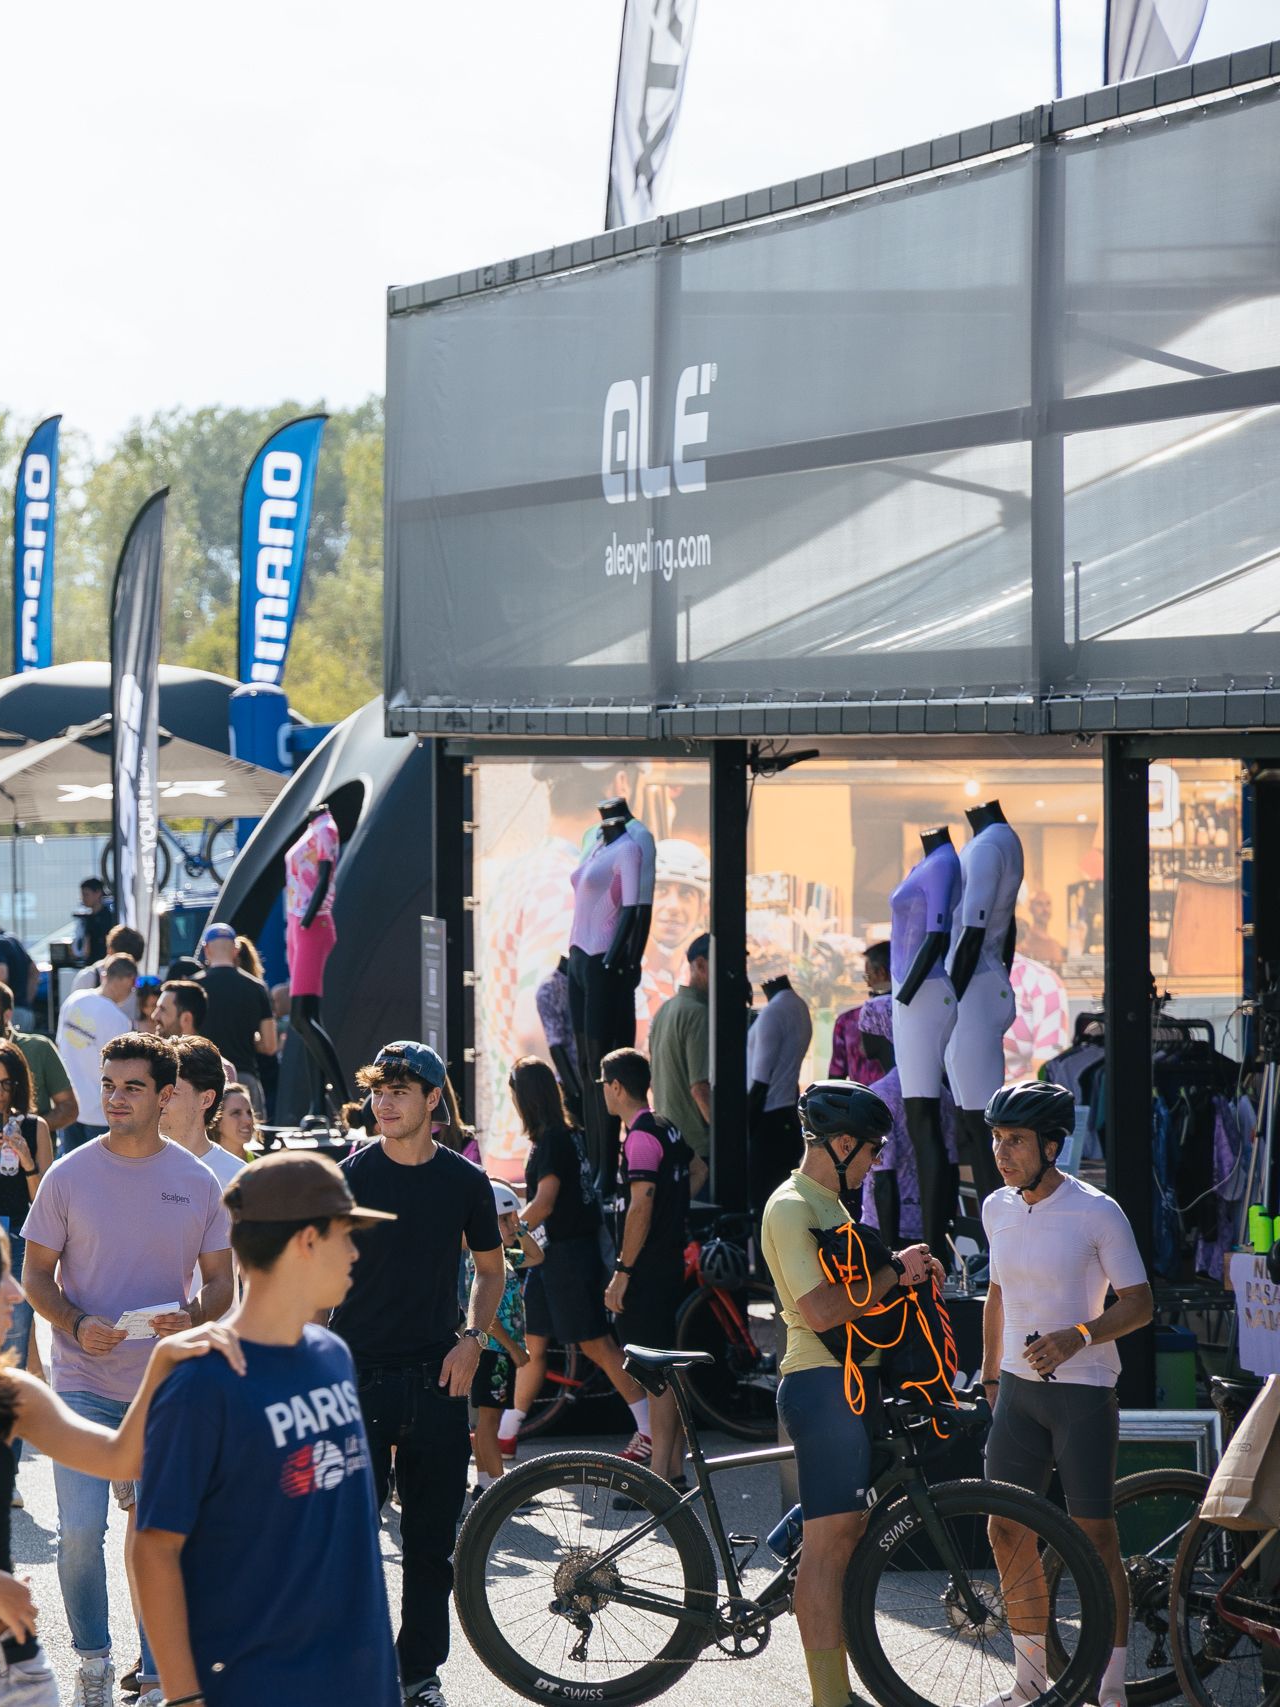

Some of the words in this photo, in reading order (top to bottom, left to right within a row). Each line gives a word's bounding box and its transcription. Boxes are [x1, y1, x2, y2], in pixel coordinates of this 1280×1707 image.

[605, 529, 711, 585] alecycling.com
[138, 792, 157, 846] YOUR
[264, 1380, 363, 1449] PARIS
[879, 1514, 914, 1552] SWISS
[534, 1677, 561, 1694] DT
[562, 1686, 604, 1701] SWISS
